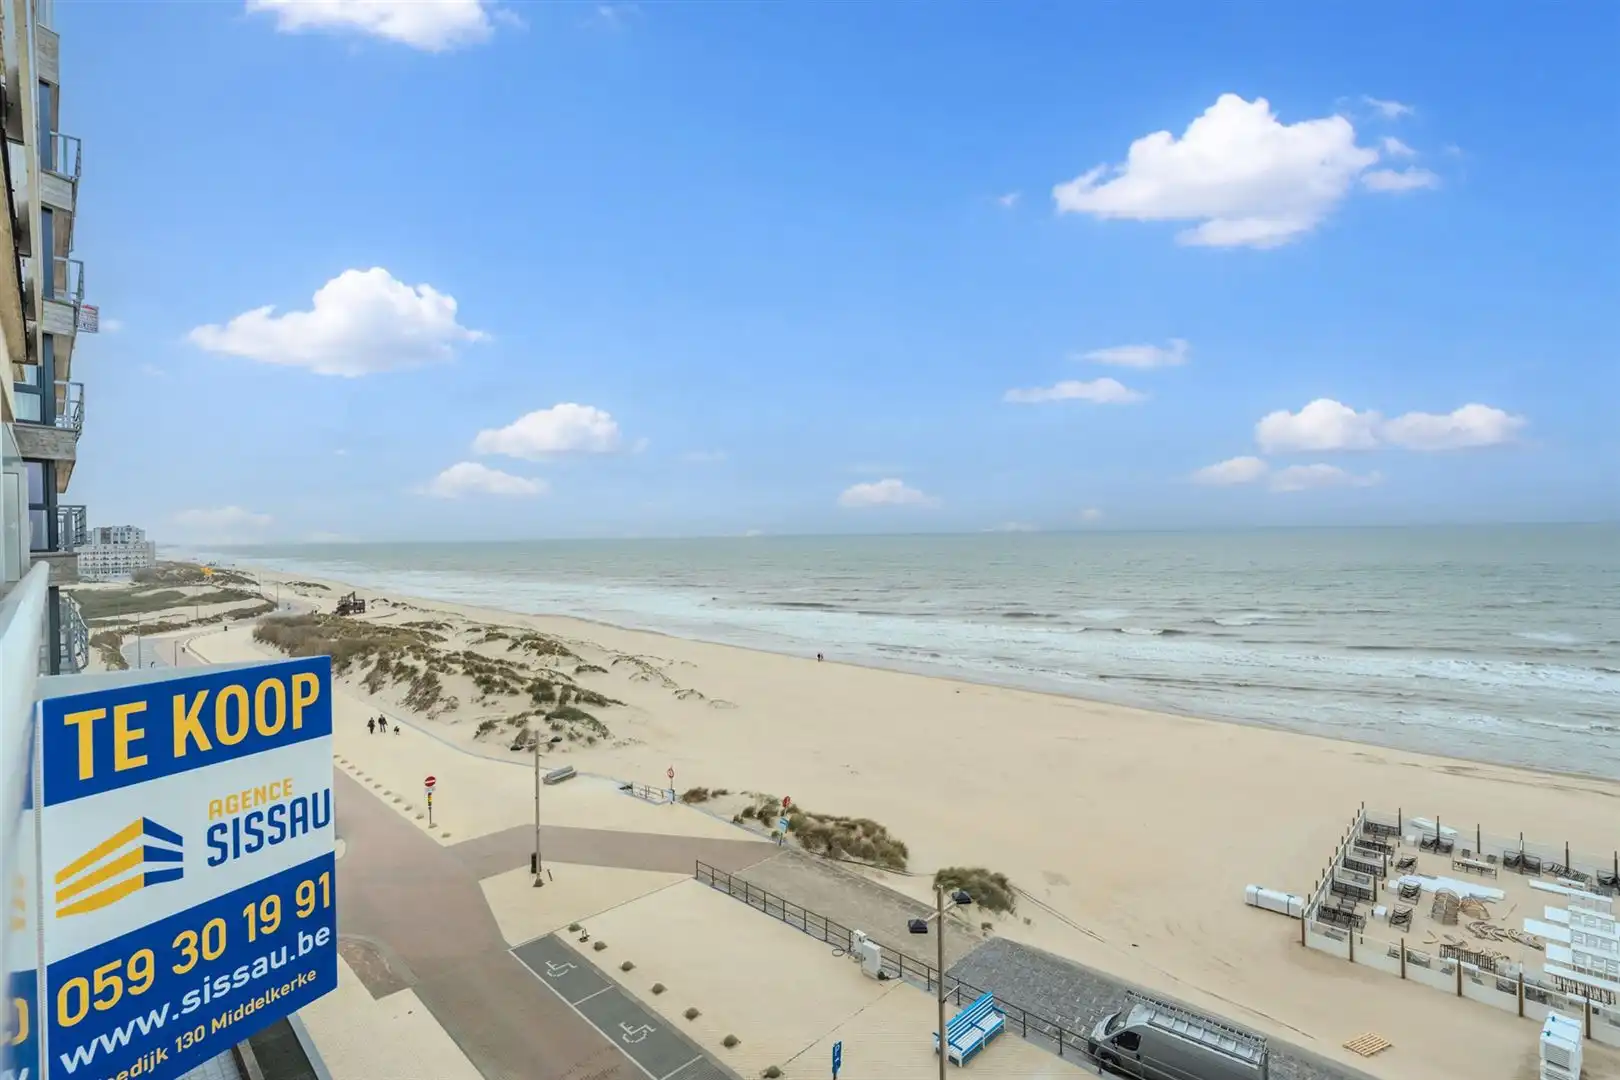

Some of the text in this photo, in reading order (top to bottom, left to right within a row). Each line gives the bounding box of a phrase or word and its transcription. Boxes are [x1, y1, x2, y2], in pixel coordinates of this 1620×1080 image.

[64, 672, 320, 781] TE KOOP
[206, 788, 331, 867] SISSAU
[208, 778, 294, 820] AGENCE
[56, 948, 155, 1028] 059
[172, 917, 227, 975] 30
[243, 893, 282, 944] 19
[295, 870, 331, 918] 91
[59, 926, 331, 1075] www.sissau.be
[174, 1024, 206, 1054] 130
[210, 967, 317, 1035] Middelkerke
